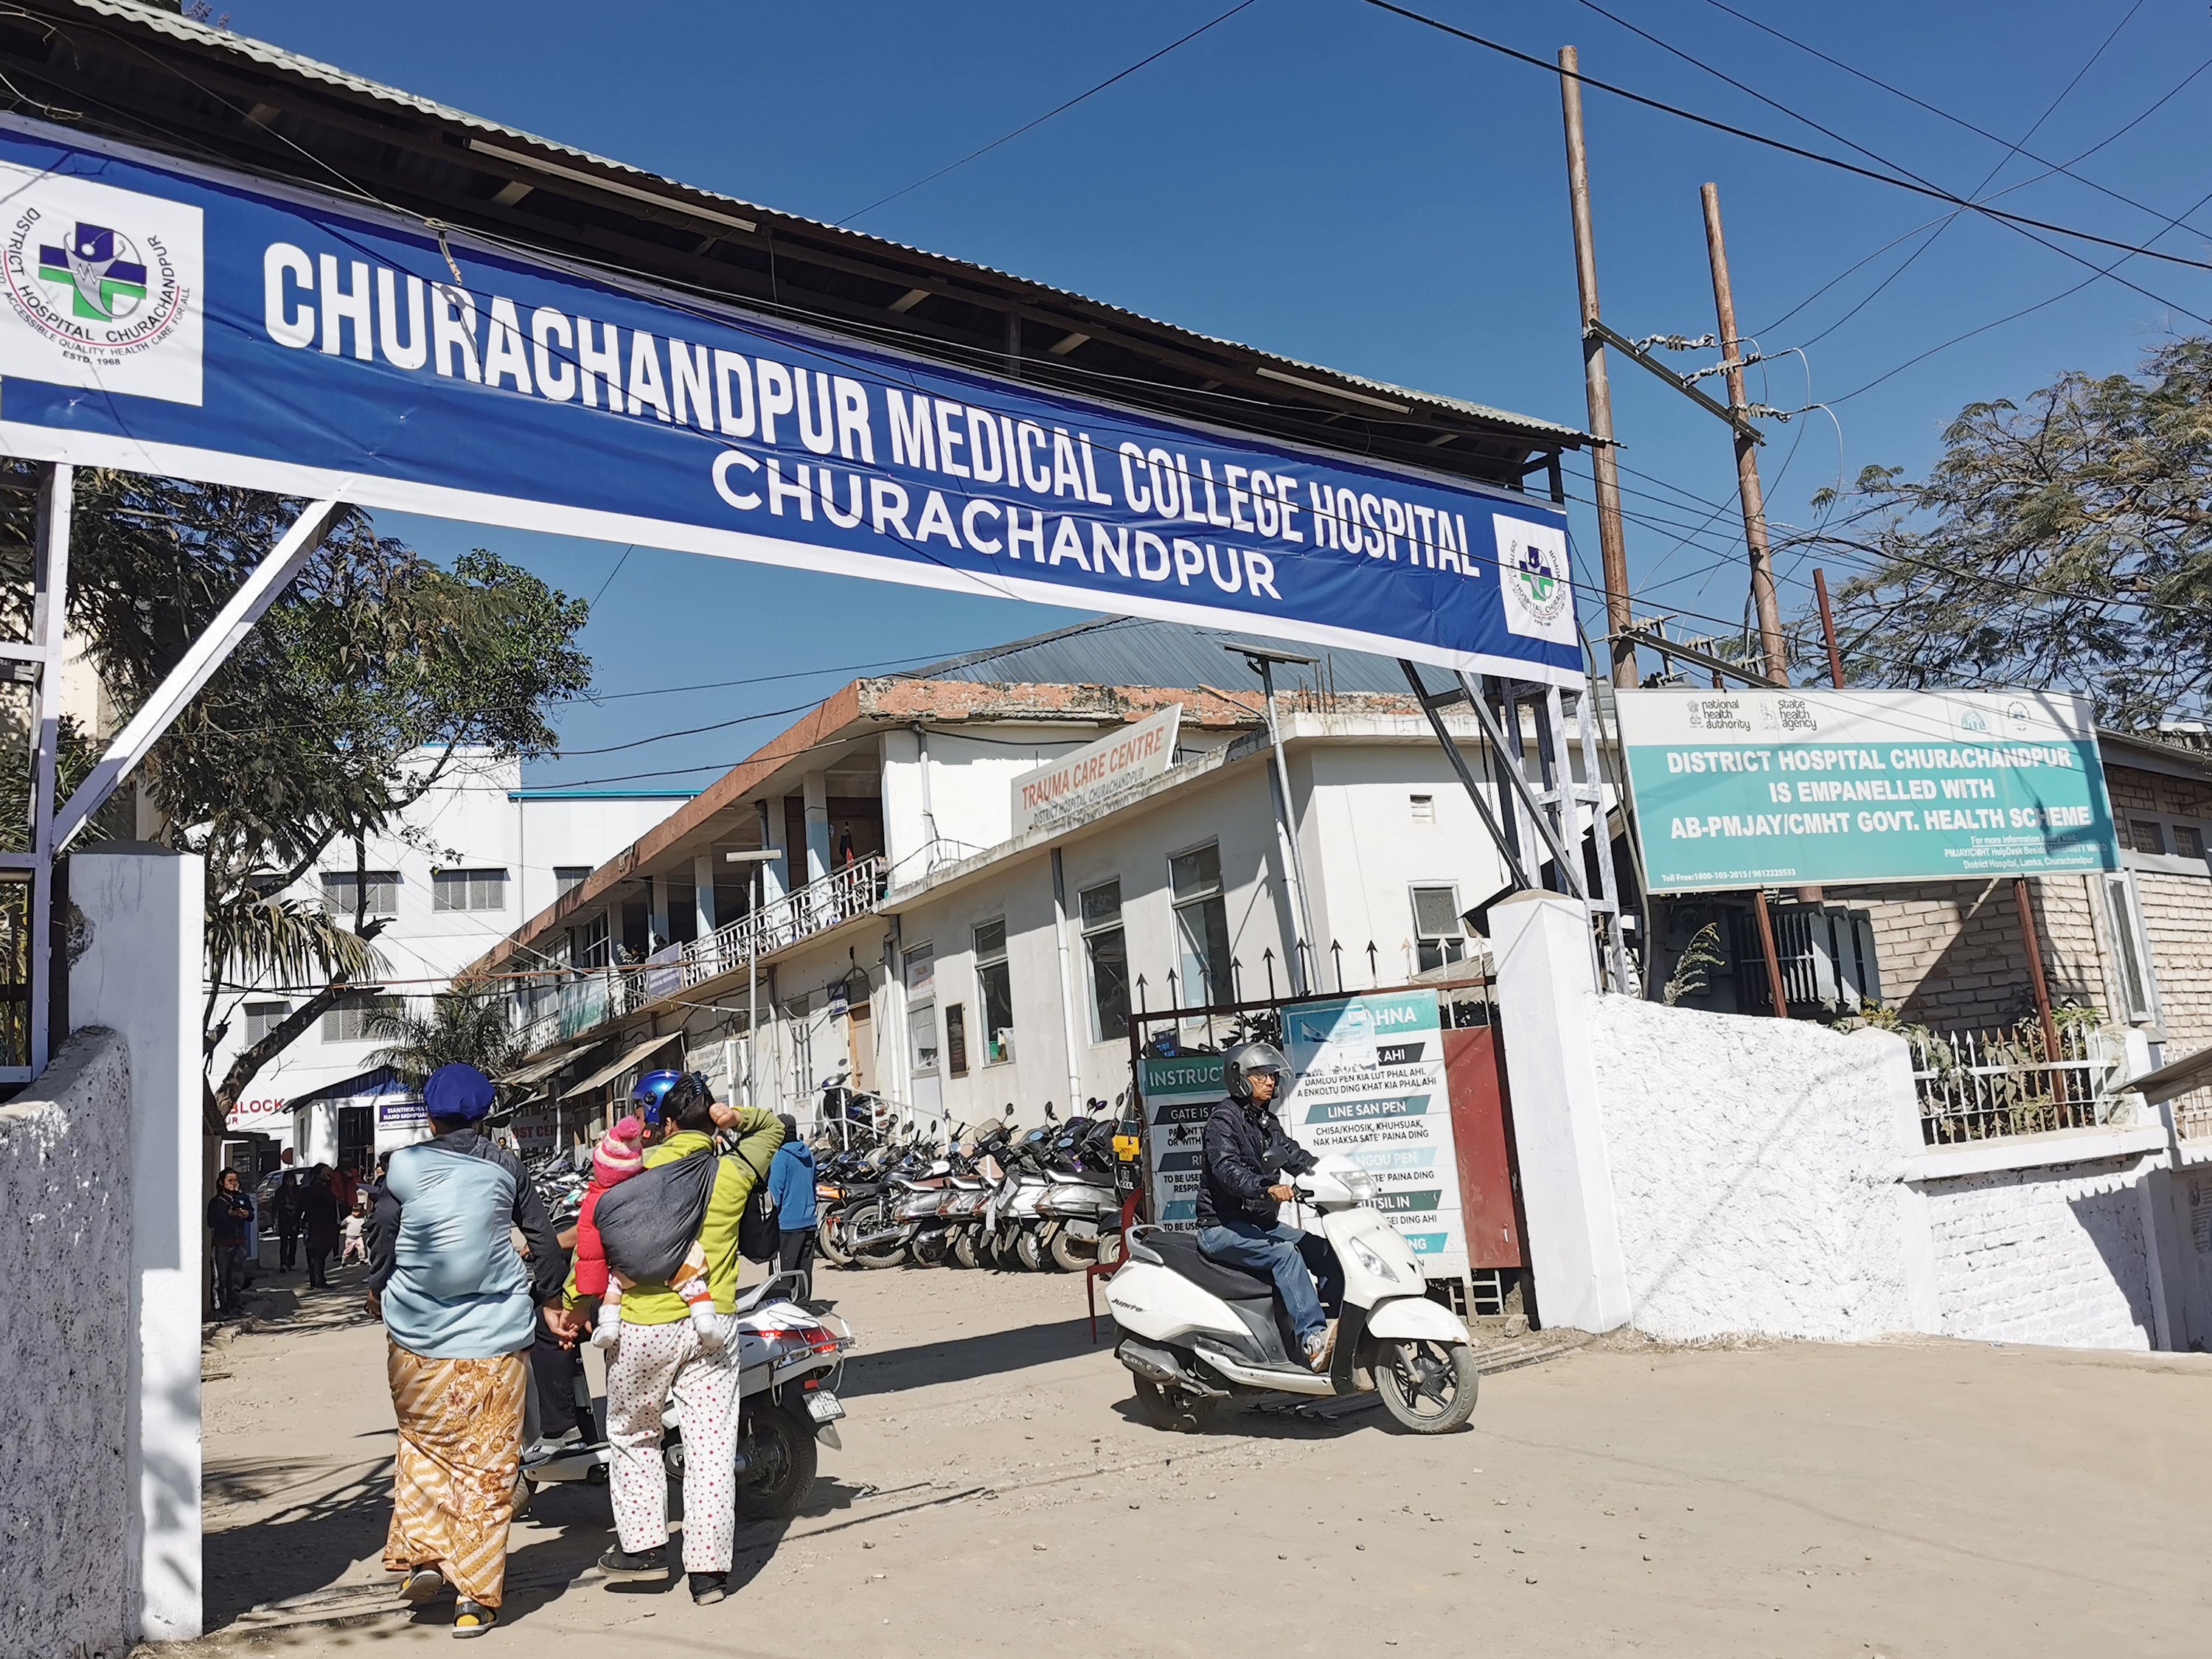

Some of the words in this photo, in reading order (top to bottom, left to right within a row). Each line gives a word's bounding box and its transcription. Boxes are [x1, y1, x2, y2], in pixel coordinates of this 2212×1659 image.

[9, 207, 41, 276] DISTRICT
[105, 234, 175, 343] CHURACHANDPUR
[18, 285, 94, 341] HOSPITAL
[4, 291, 57, 342] ACCESSIBLE
[59, 338, 105, 355] QUALITY
[111, 343, 150, 356] HEALTH
[150, 325, 175, 346] CARE
[171, 307, 184, 325] FOR
[182, 287, 190, 307] ALL
[62, 349, 93, 364] ESTD.
[263, 241, 876, 465] CHURACHANDPUR
[886, 388, 1114, 507] MEDICAL
[1119, 440, 1305, 543] COLLEGE
[1308, 481, 1481, 578] HOSPITAL
[712, 450, 1283, 601] CHURACHANDPUR
[1701, 699, 1739, 709] national
[1778, 699, 1805, 709] state
[1703, 708, 1733, 719] health
[1779, 707, 1810, 719] health
[1705, 718, 1751, 731] authority
[1782, 718, 1818, 731] agency
[1666, 751, 1772, 773] DISTRICT
[1778, 749, 1885, 771] HOSPITAL
[1890, 747, 2073, 770] CHURACHANDPUR
[1022, 769, 1070, 810] TRAUMA
[1073, 752, 1107, 789] CARE
[1110, 726, 1164, 773] CENTRE
[1034, 803, 1058, 824] DISTRICT
[1088, 766, 1144, 803] CHURACHANDPUR
[1769, 782, 1792, 803] IS
[1797, 779, 1937, 802] EMPANELLED
[1940, 778, 1996, 799] WITH
[1671, 812, 1851, 839] AB-PMJAY/CMHT
[1857, 811, 1920, 832] GOVT.
[1924, 808, 2006, 831] HEALTH
[2009, 806, 2093, 828] SCHEME
[1970, 836, 1983, 845] For
[1984, 836, 2002, 845] more
[2003, 835, 2040, 844] information
[1991, 846, 2023, 858] HelpDesk
[1963, 859, 1989, 869] District
[1989, 858, 2019, 869] Hospital,
[2044, 855, 2094, 868] Churachandpur
[1661, 874, 1675, 883] Toll
[1752, 869, 1796, 877] 9612225533
[1384, 1048, 1405, 1062] AHI
[1149, 1066, 1225, 1088] INSTRUC
[1339, 1074, 1354, 1084] PEN
[1357, 1072, 1370, 1082] KIA
[1371, 1071, 1385, 1080] LUT
[1387, 1069, 1408, 1078] PHAL
[1409, 1067, 1427, 1077] AHI.
[1340, 1083, 1360, 1093] DING
[1362, 1082, 1382, 1091] KHAT
[1384, 1080, 1397, 1089] KIA
[1399, 1077, 1421, 1088] PHAL
[1422, 1077, 1437, 1085] AHI
[1170, 1107, 1197, 1120] GATE
[1200, 1107, 1209, 1118] IS
[1327, 1105, 1354, 1119] LINE
[1355, 1102, 1380, 1116] SAN
[1382, 1101, 1407, 1113] PEN
[1315, 1123, 1375, 1135] CHISA/KHOSIK,
[1376, 1119, 1424, 1130] KHUHSUAK,
[1167, 1138, 1179, 1147] OR
[1181, 1136, 1201, 1146] WITH
[1312, 1138, 1330, 1147] NAK
[1332, 1135, 1358, 1145] HAKSA
[1382, 1132, 1408, 1141] PAINA
[1408, 1129, 1429, 1138] DING
[1357, 1154, 1391, 1167] NGOU
[1394, 1151, 1419, 1165] PEN
[1164, 1175, 1174, 1183] TO
[1175, 1174, 1184, 1183] BE
[1387, 1171, 1413, 1181] PAINA
[1413, 1170, 1434, 1180] DING
[1396, 1195, 1411, 1209] IN
[1164, 1223, 1174, 1232] TO
[1175, 1222, 1184, 1231] BE
[1400, 1215, 1421, 1225] DING
[1422, 1214, 1437, 1223] AHI
